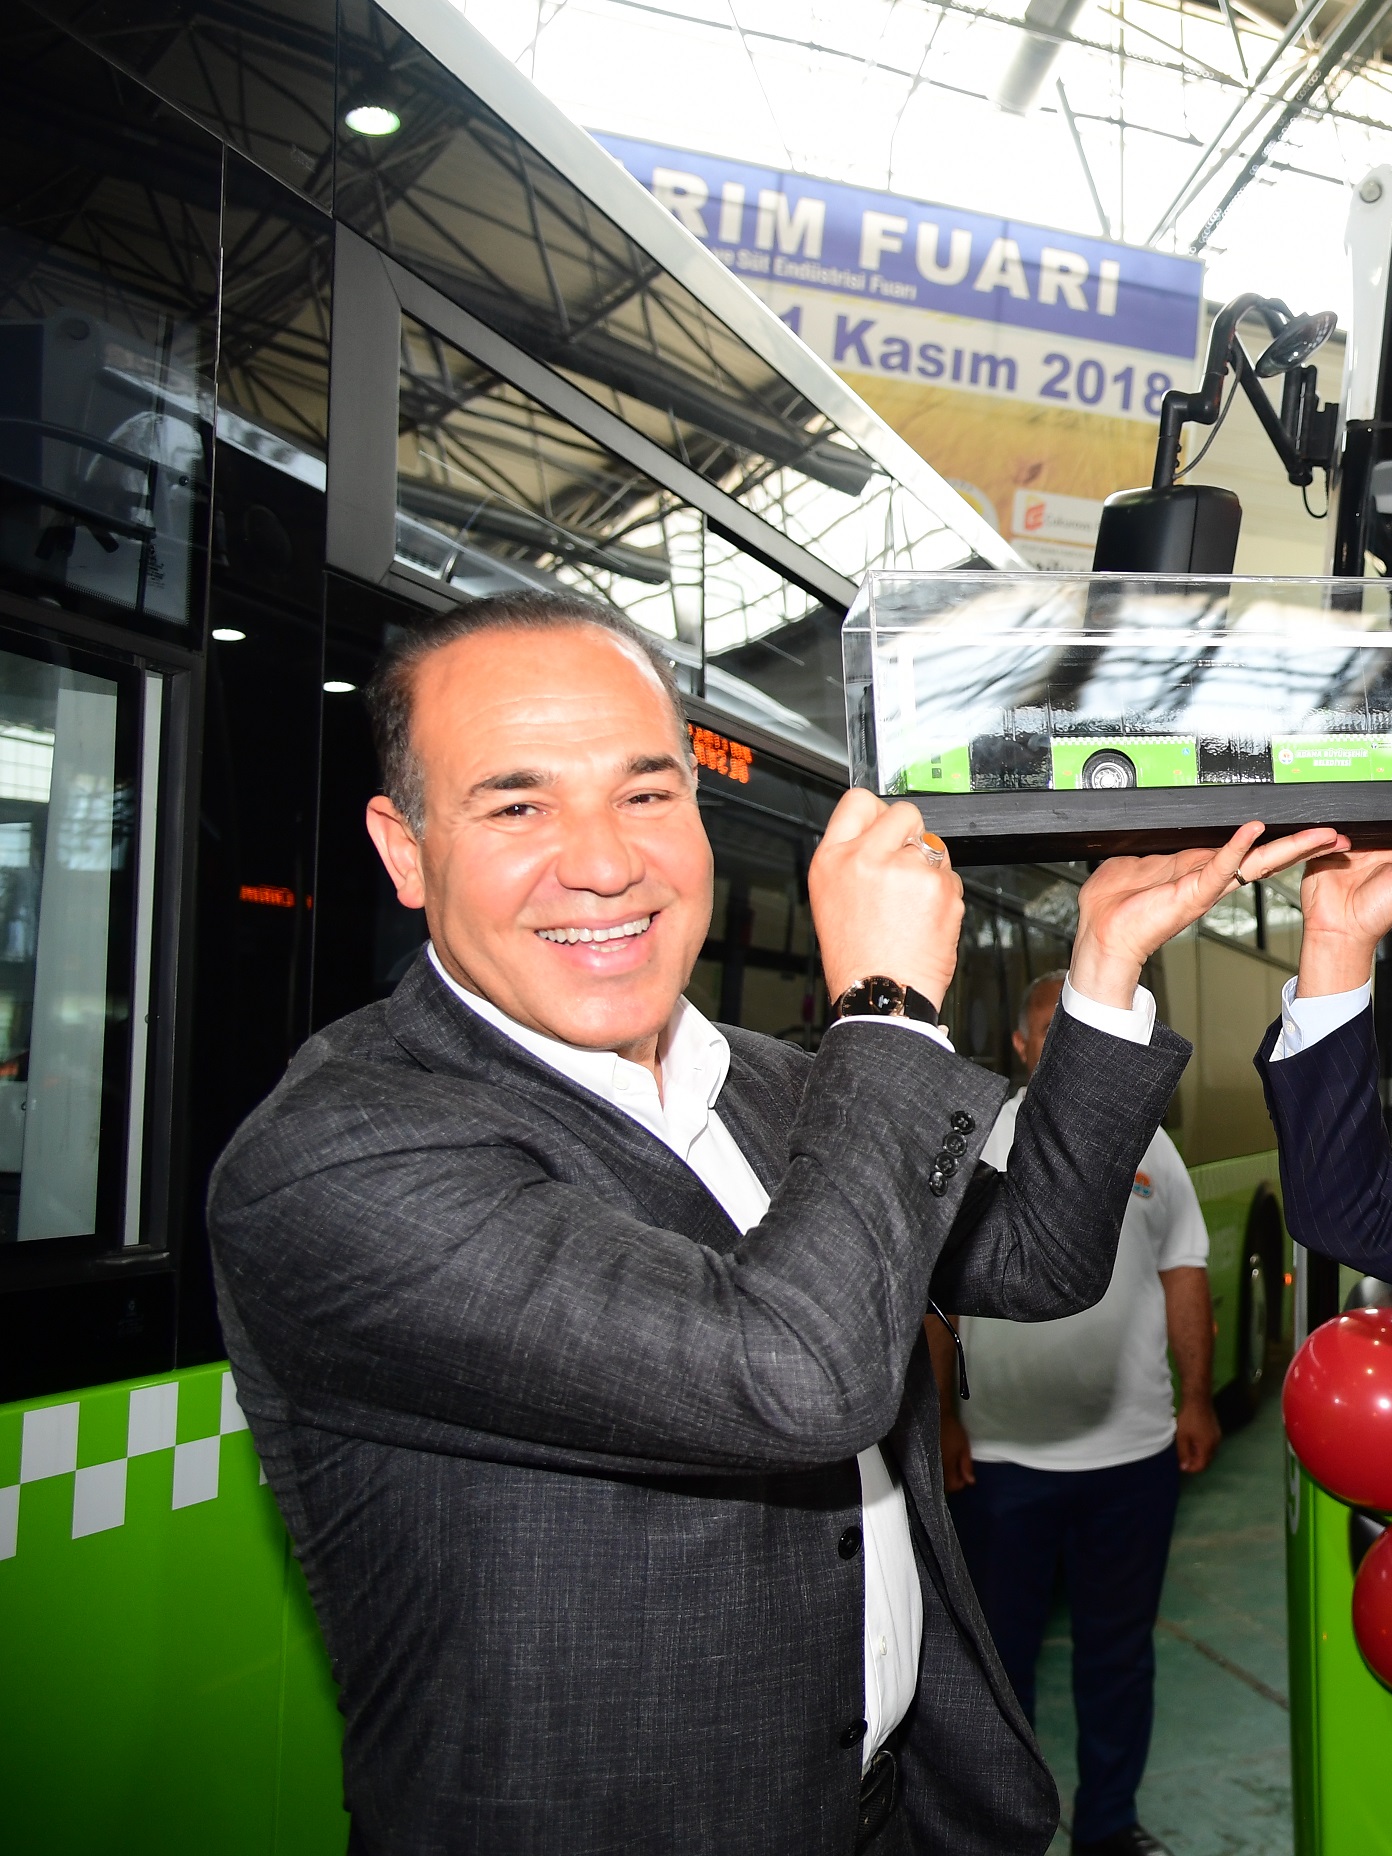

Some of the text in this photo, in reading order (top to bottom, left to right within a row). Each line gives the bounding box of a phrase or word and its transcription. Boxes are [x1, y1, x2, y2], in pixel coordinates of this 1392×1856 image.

[650, 166, 1121, 318] RIM FUARI
[832, 314, 1018, 391] Kasım
[1038, 352, 1173, 416] 2018
